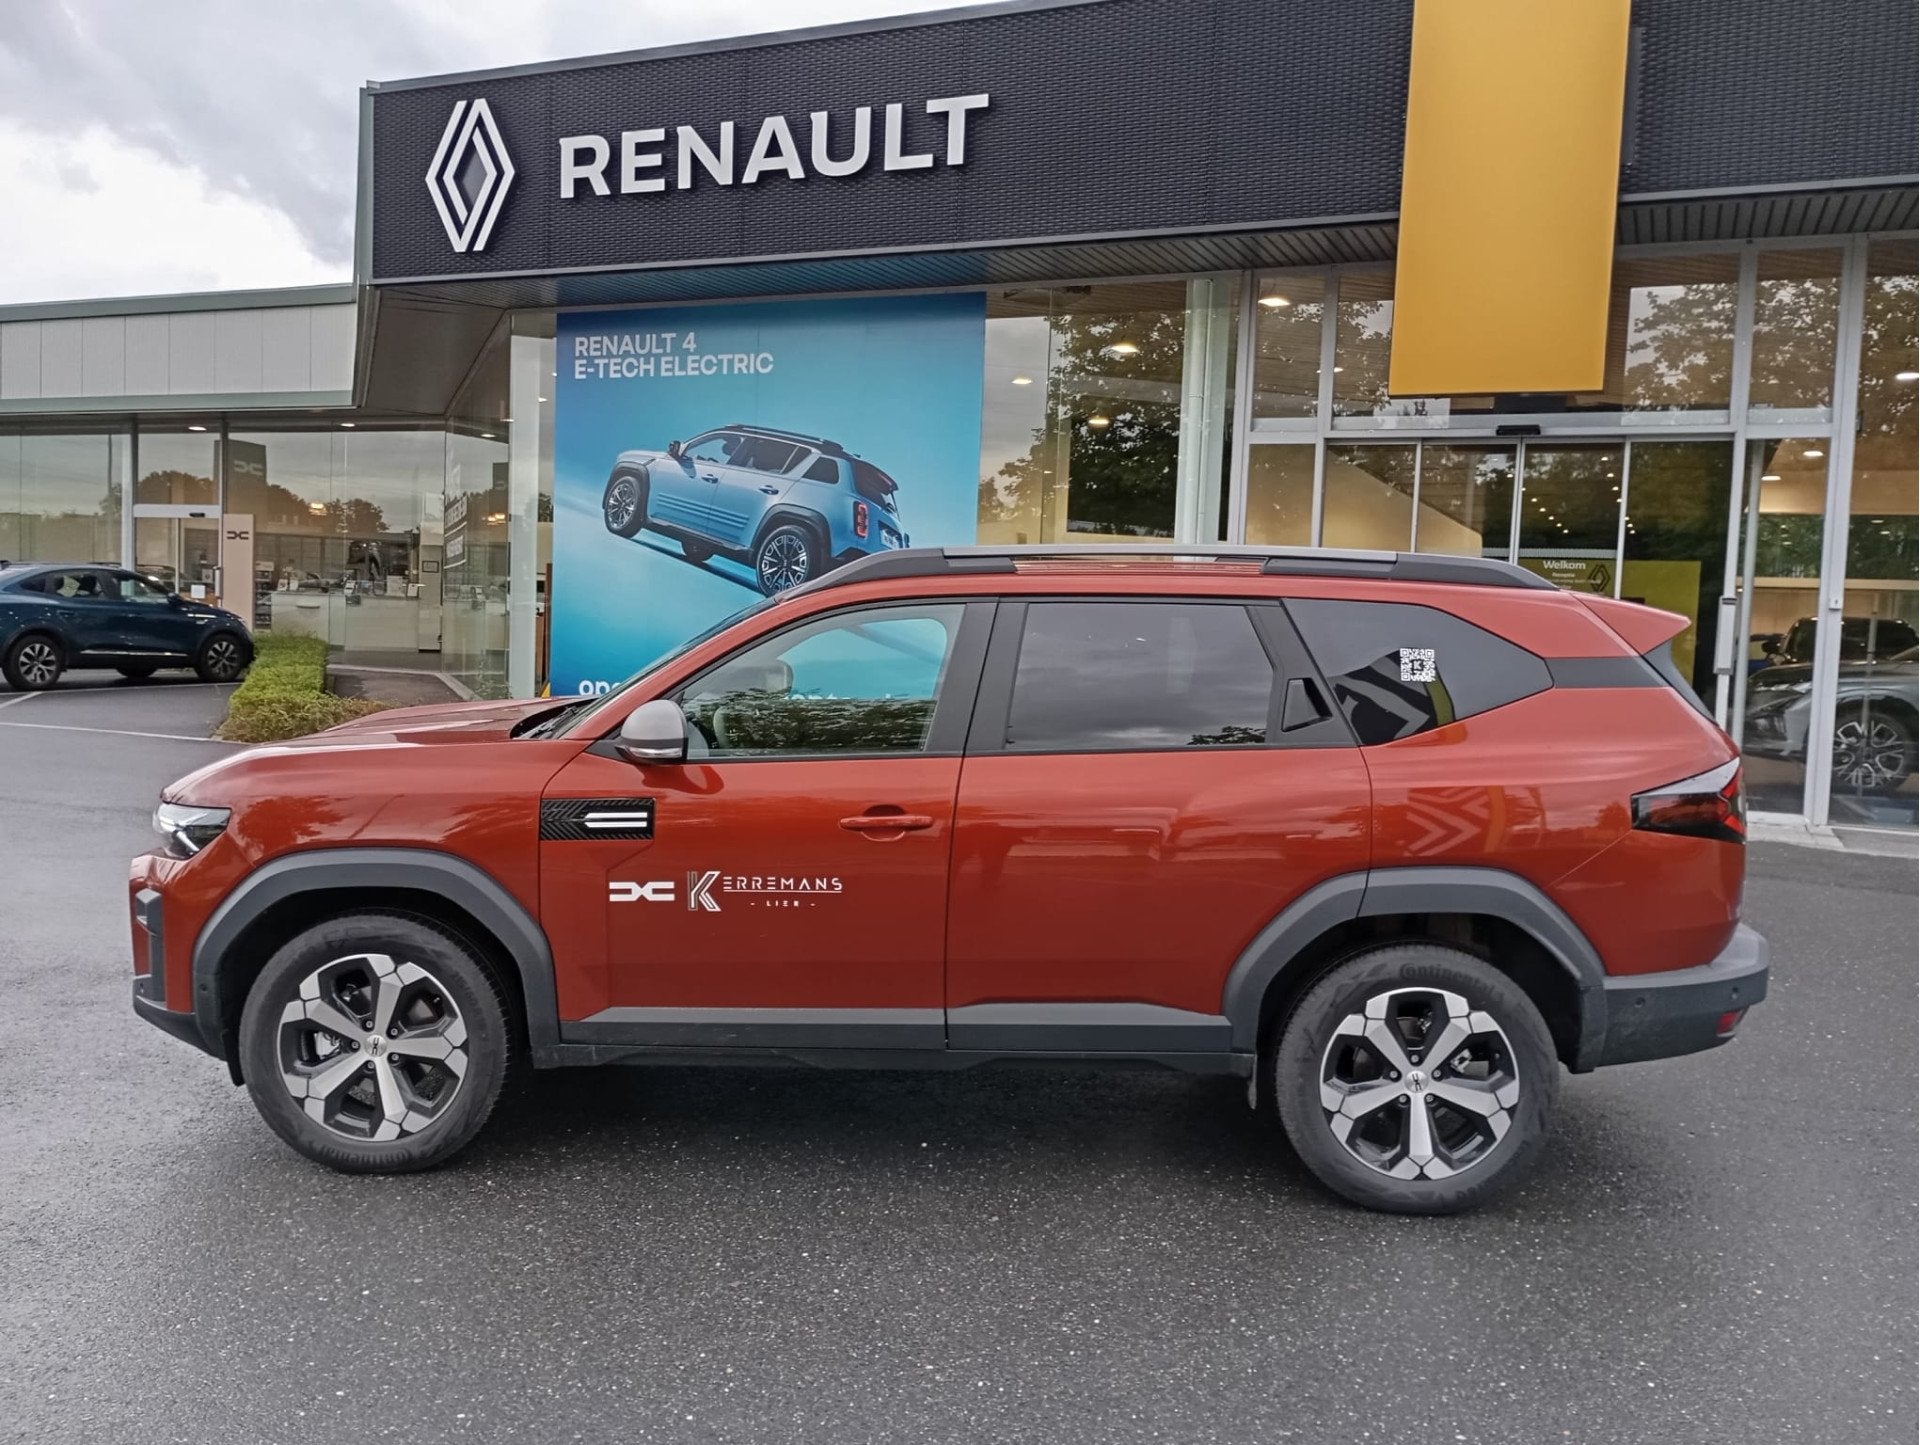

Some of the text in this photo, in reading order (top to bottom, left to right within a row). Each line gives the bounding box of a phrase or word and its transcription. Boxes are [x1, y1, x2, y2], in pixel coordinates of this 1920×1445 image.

[558, 93, 990, 199] RENAULT
[574, 332, 697, 357] RENAULT 4
[574, 352, 774, 379] E-TECH ELECTRIC
[1543, 560, 1586, 570] Welkom
[766, 900, 800, 908] LIER
